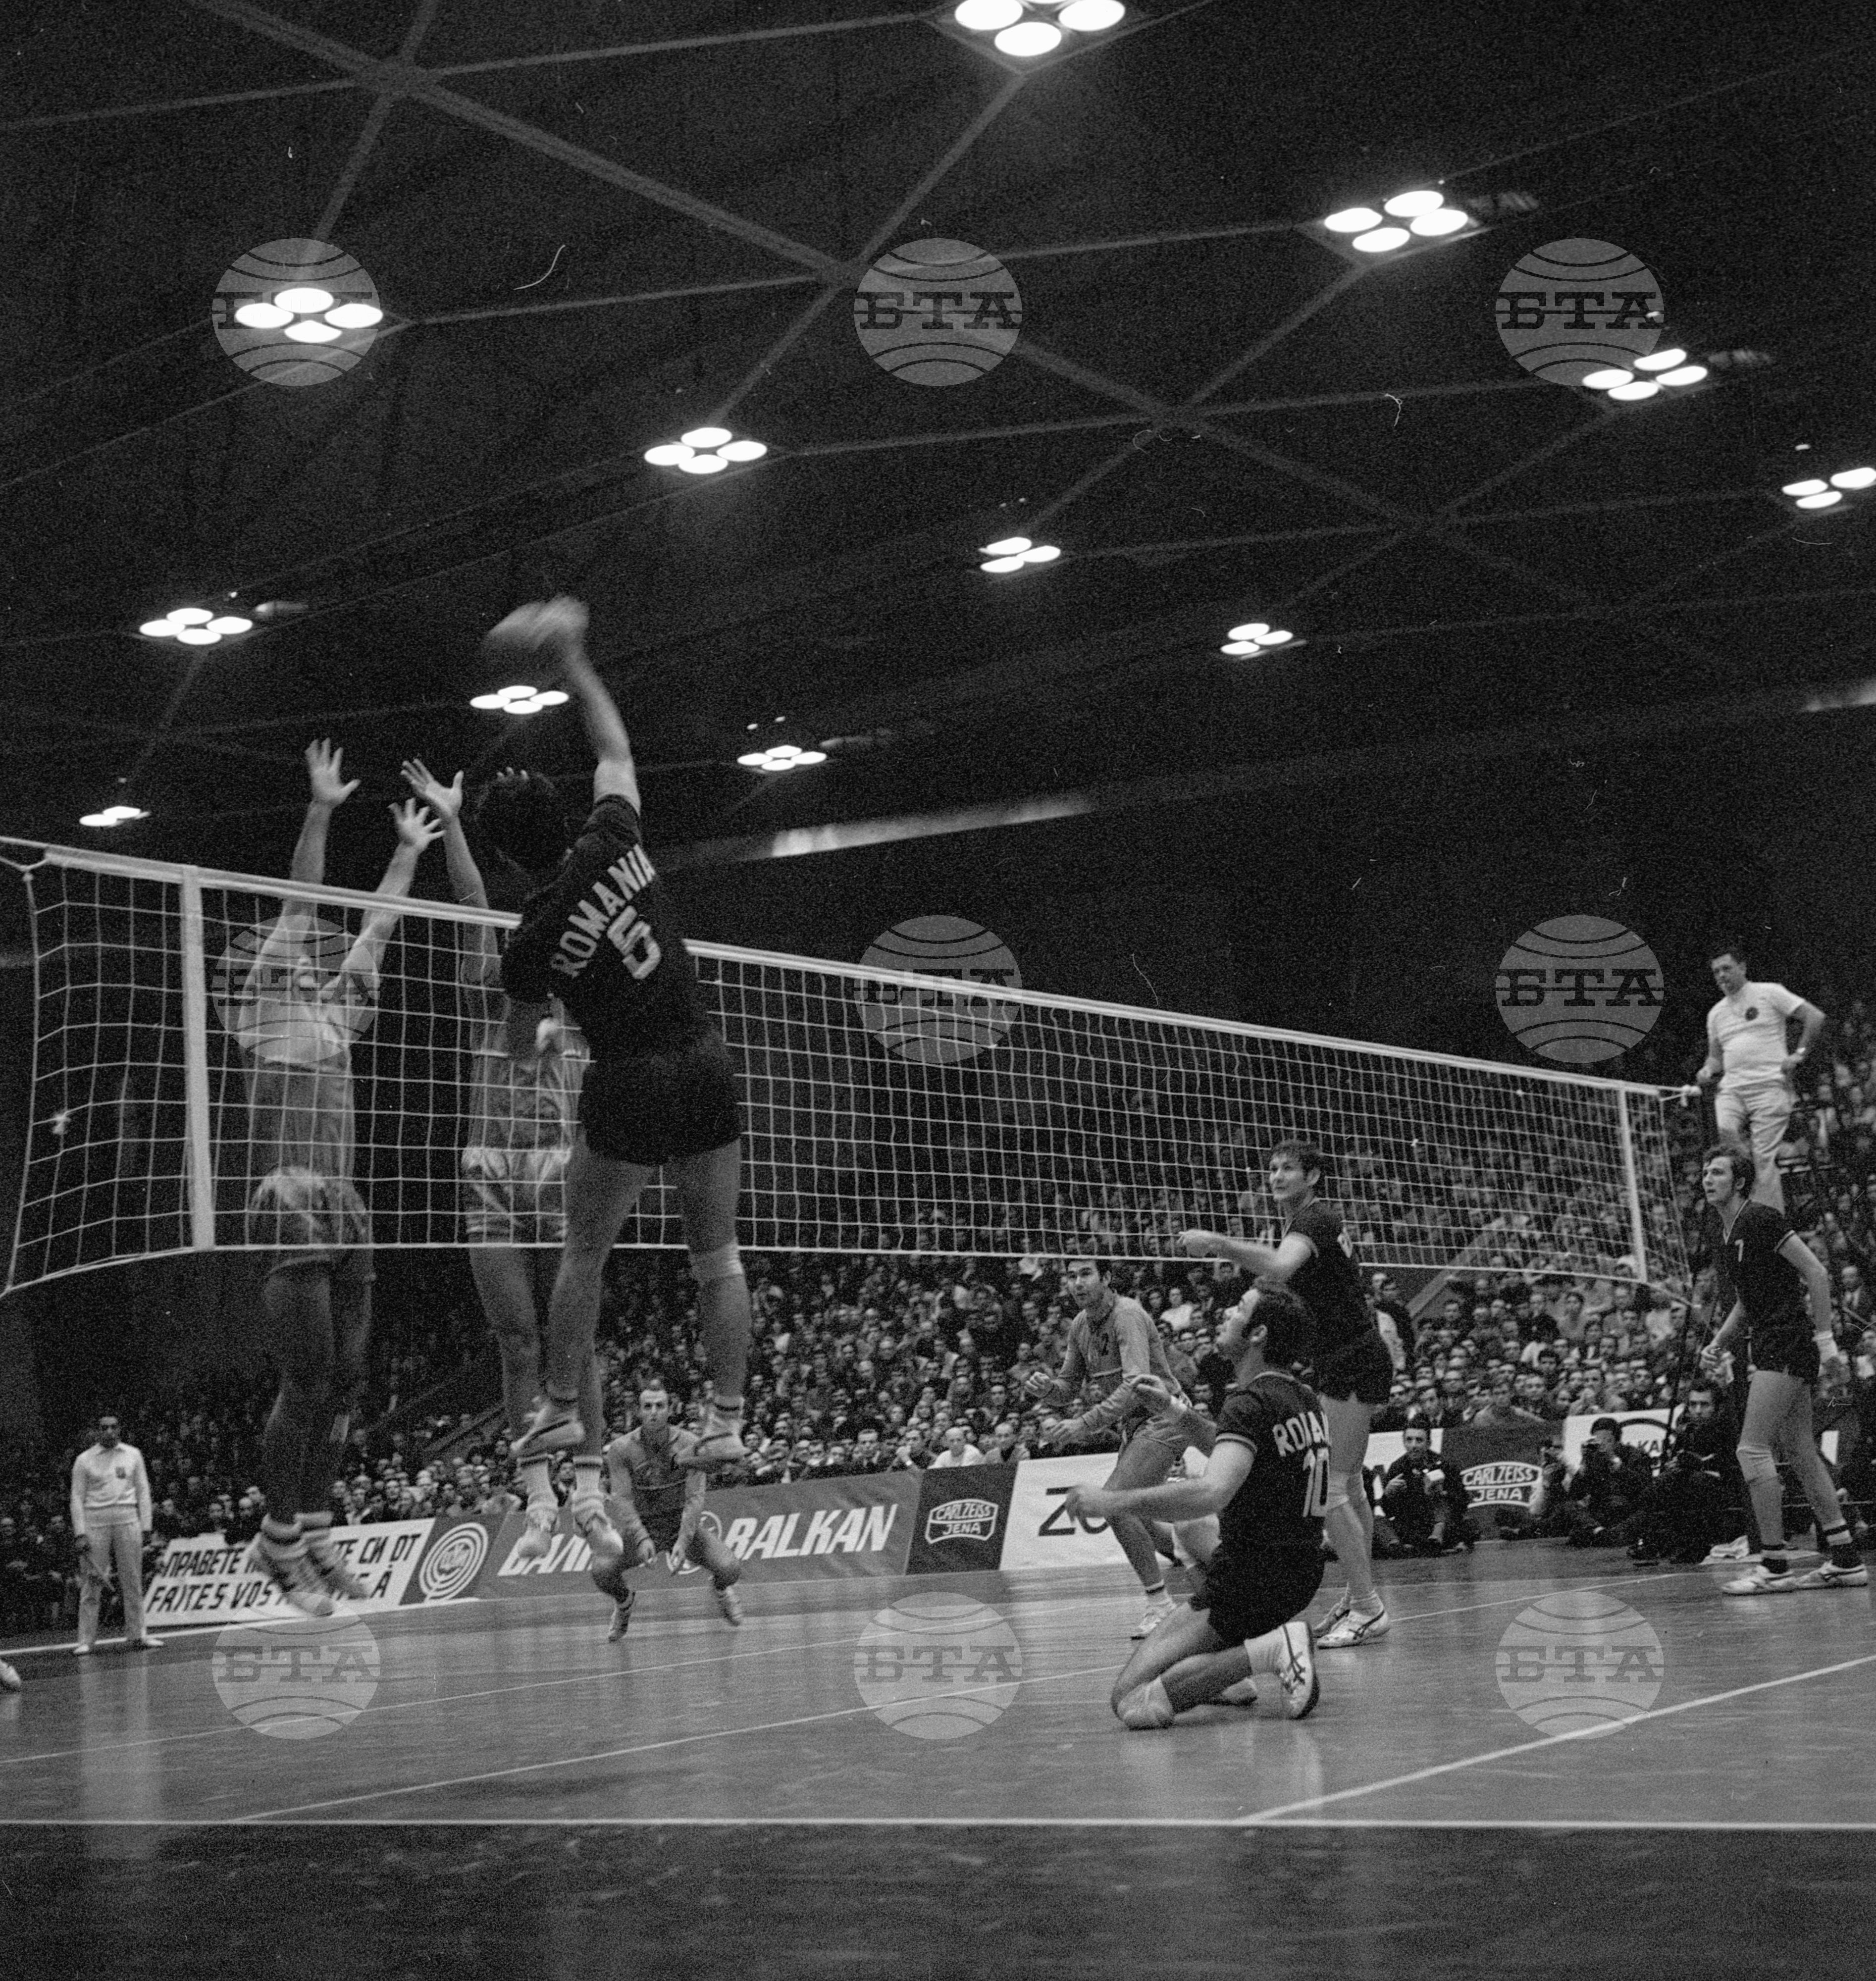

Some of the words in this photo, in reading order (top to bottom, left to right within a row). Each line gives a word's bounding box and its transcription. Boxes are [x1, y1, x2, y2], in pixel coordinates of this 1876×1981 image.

[550, 843, 656, 979] ROMANIA
[607, 905, 662, 979] 5
[1303, 1448, 1330, 1517] 10
[1472, 1487, 1523, 1502] JENA
[390, 1533, 422, 1562] ОТ
[724, 1504, 899, 1561] BALKAN
[942, 1522, 982, 1535] JENA
[146, 1582, 229, 1614] FAITES
[229, 1580, 273, 1609] VOS
